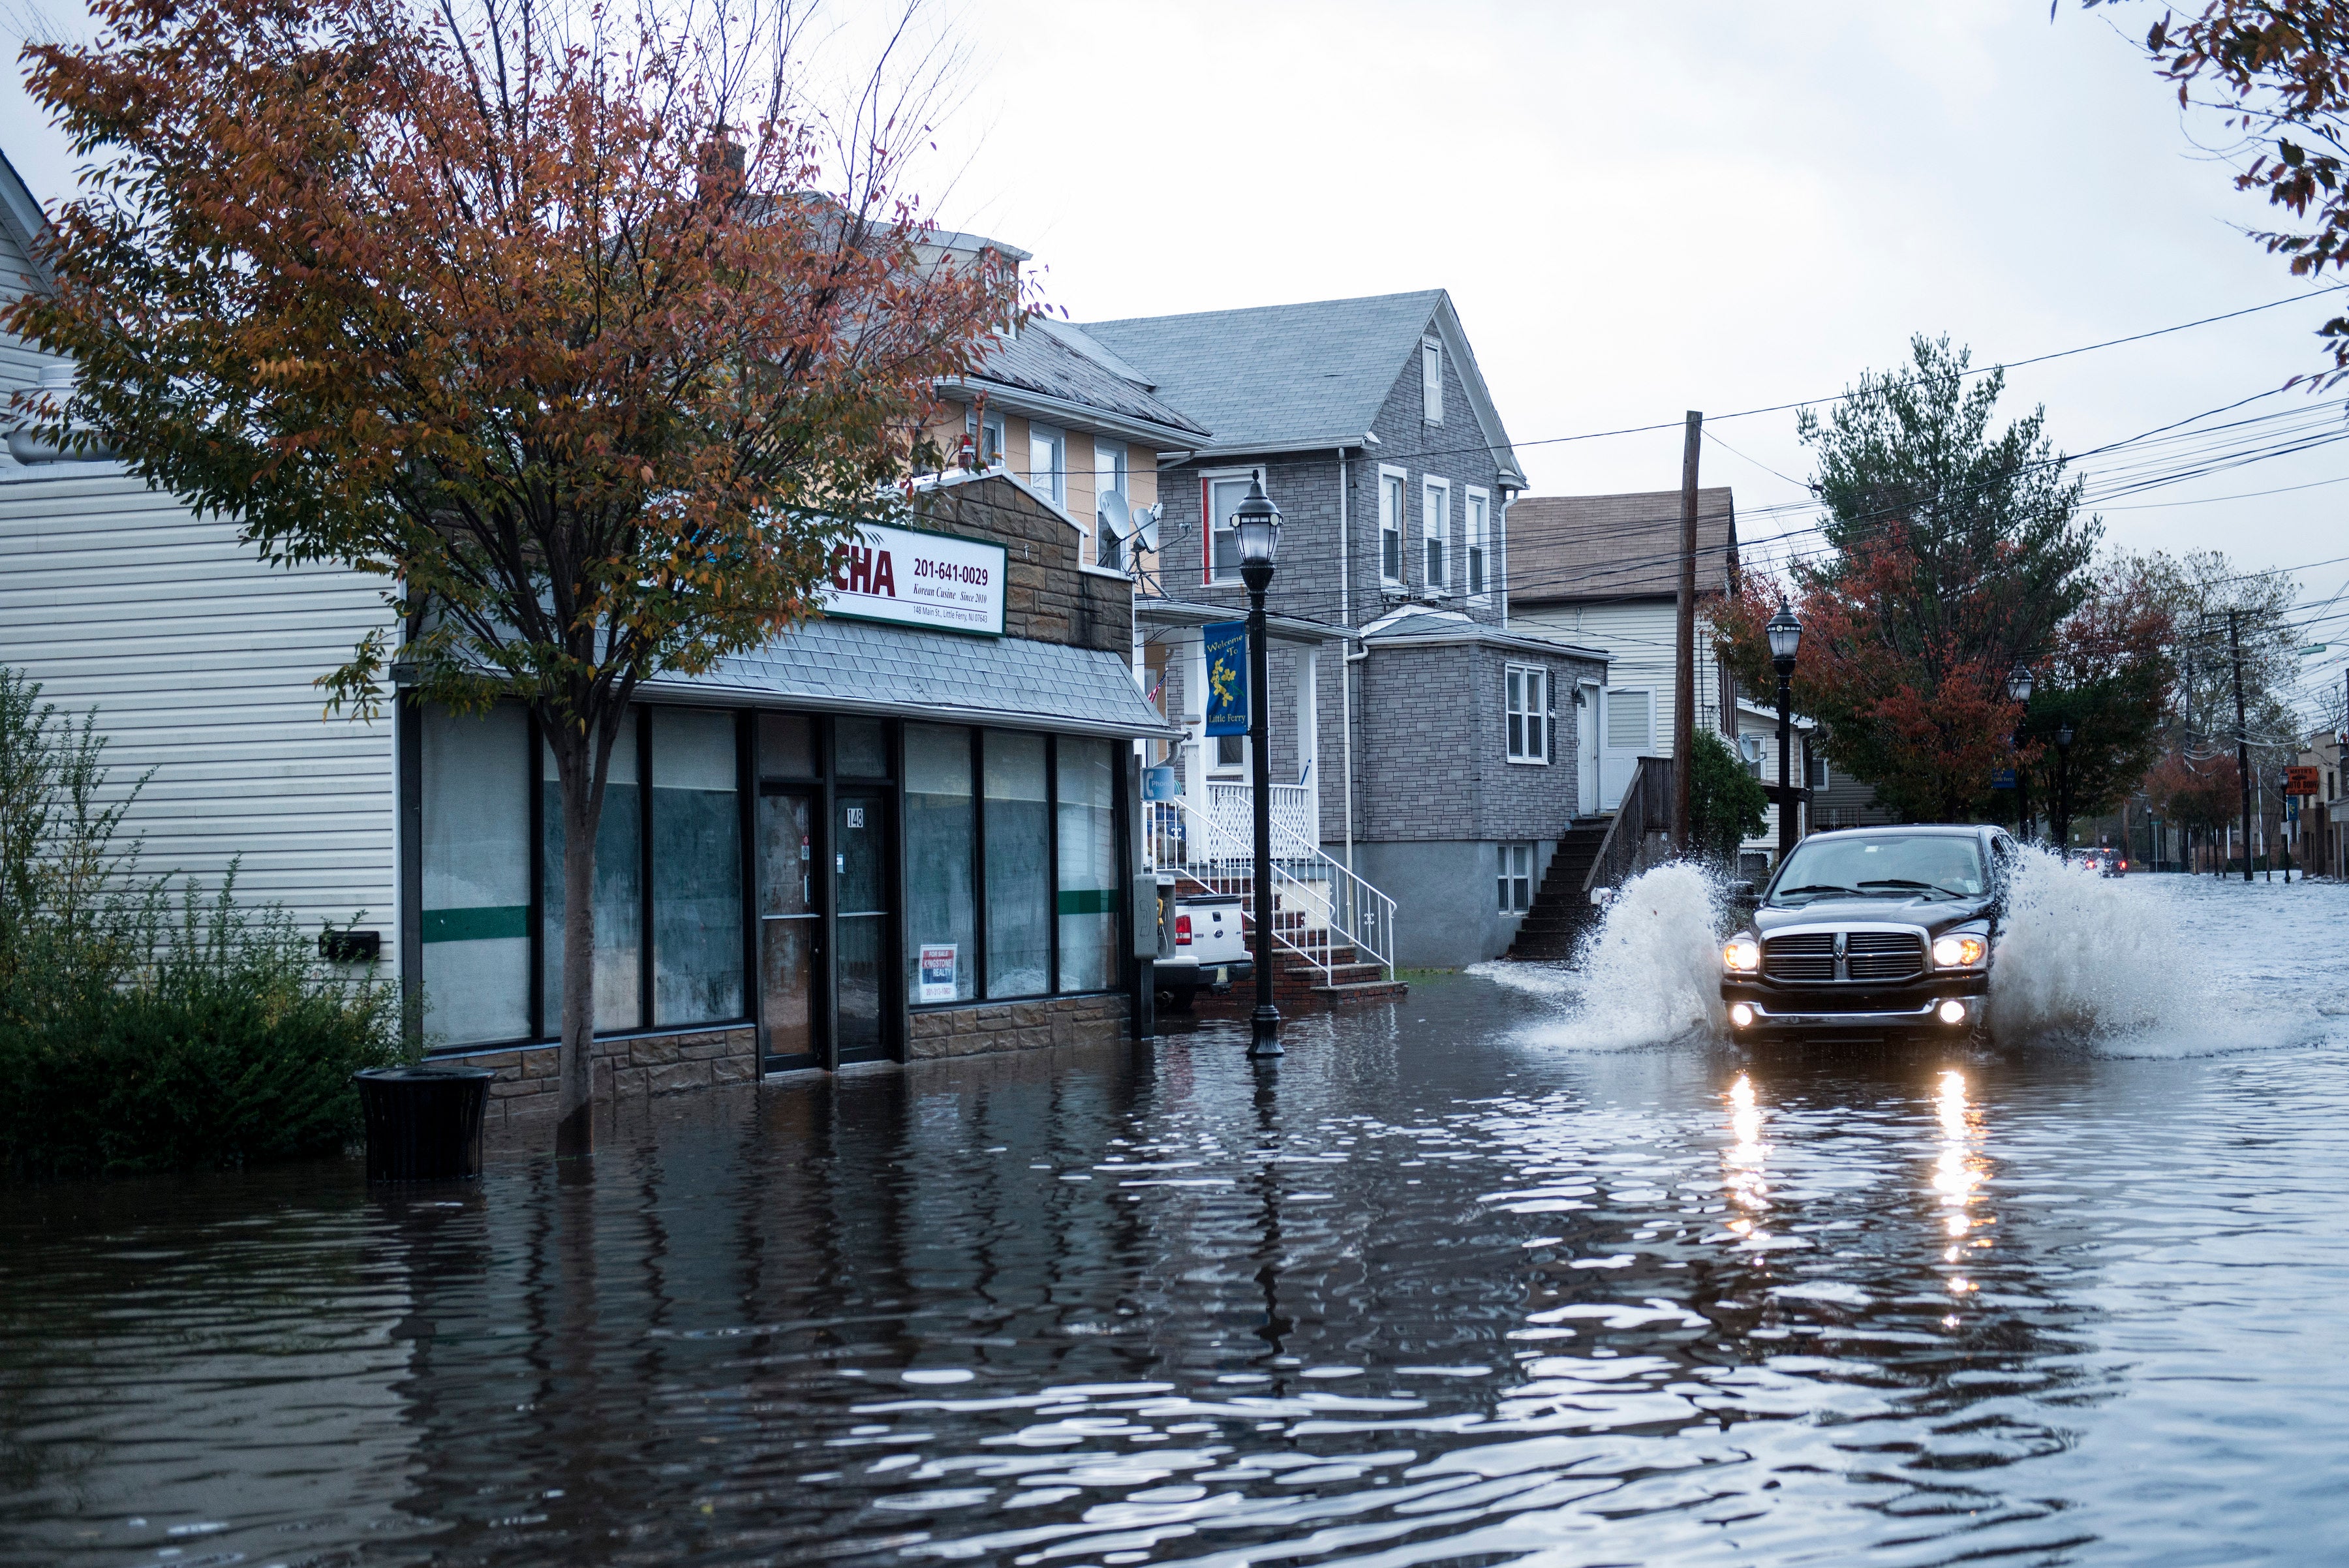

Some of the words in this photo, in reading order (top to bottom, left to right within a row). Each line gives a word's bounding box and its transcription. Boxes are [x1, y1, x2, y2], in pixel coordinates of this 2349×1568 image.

[914, 558, 988, 586] 201-641-0029
[914, 583, 934, 596] Korean
[936, 587, 956, 600] Cusine
[960, 591, 974, 602] Since
[975, 593, 987, 604] 2010
[922, 607, 934, 616] Main
[943, 609, 955, 619] Little
[955, 611, 968, 623] Ferry,
[968, 613, 974, 622] NJ
[975, 613, 988, 623] 07643
[1206, 635, 1243, 653] Welcome
[1227, 646, 1238, 656] To
[1208, 714, 1225, 723] Little
[1227, 713, 1246, 724] Ferry
[848, 809, 863, 827] 148
[924, 959, 952, 968] KINGSTONE
[932, 968, 952, 977] REALTY
